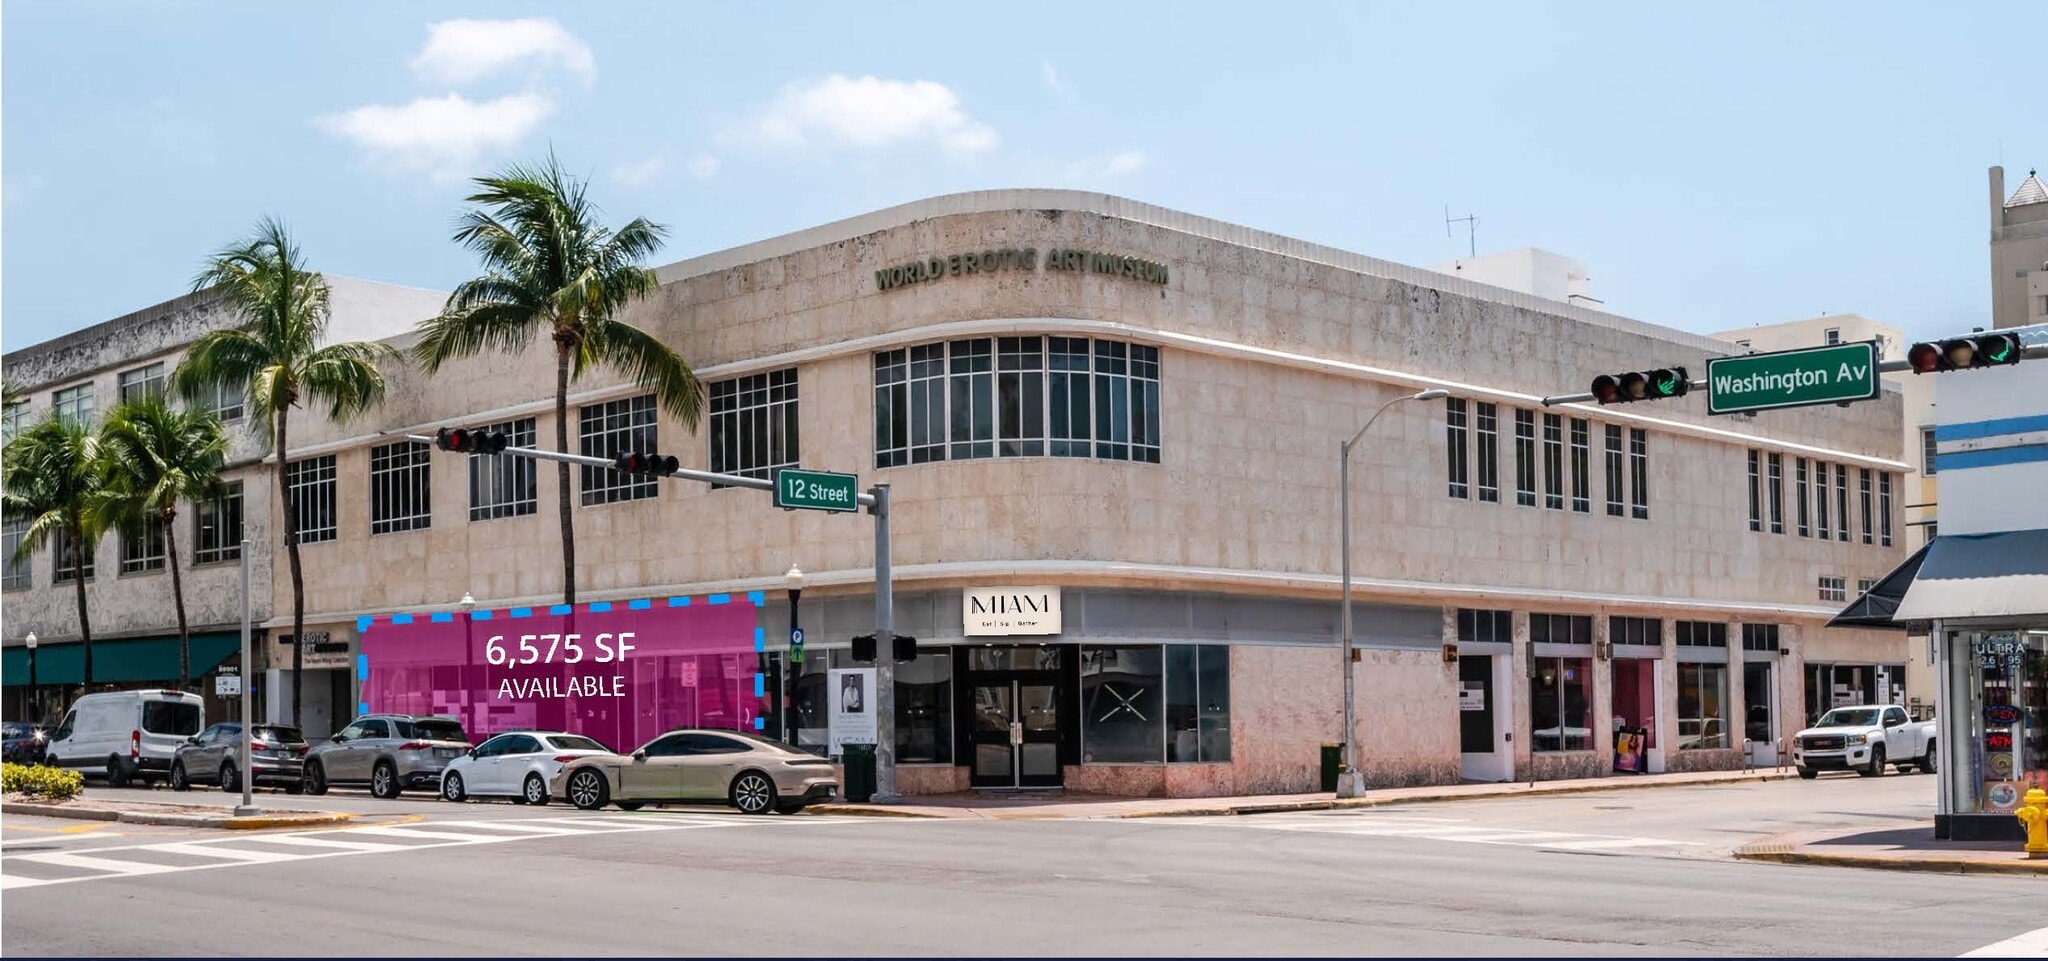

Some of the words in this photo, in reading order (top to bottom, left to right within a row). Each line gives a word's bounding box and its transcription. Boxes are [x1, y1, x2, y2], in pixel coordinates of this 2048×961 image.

[875, 257, 945, 290] WORLD
[948, 248, 1037, 277] EROTIC
[1045, 248, 1089, 272] ART
[1091, 253, 1169, 284] MUSEUM
[1715, 367, 1828, 395] Washington
[1836, 361, 1867, 383] Av
[788, 479, 806, 499] 12
[809, 483, 849, 502] Street
[971, 594, 1048, 614] MIAM
[1975, 643, 2026, 654] ULTRA
